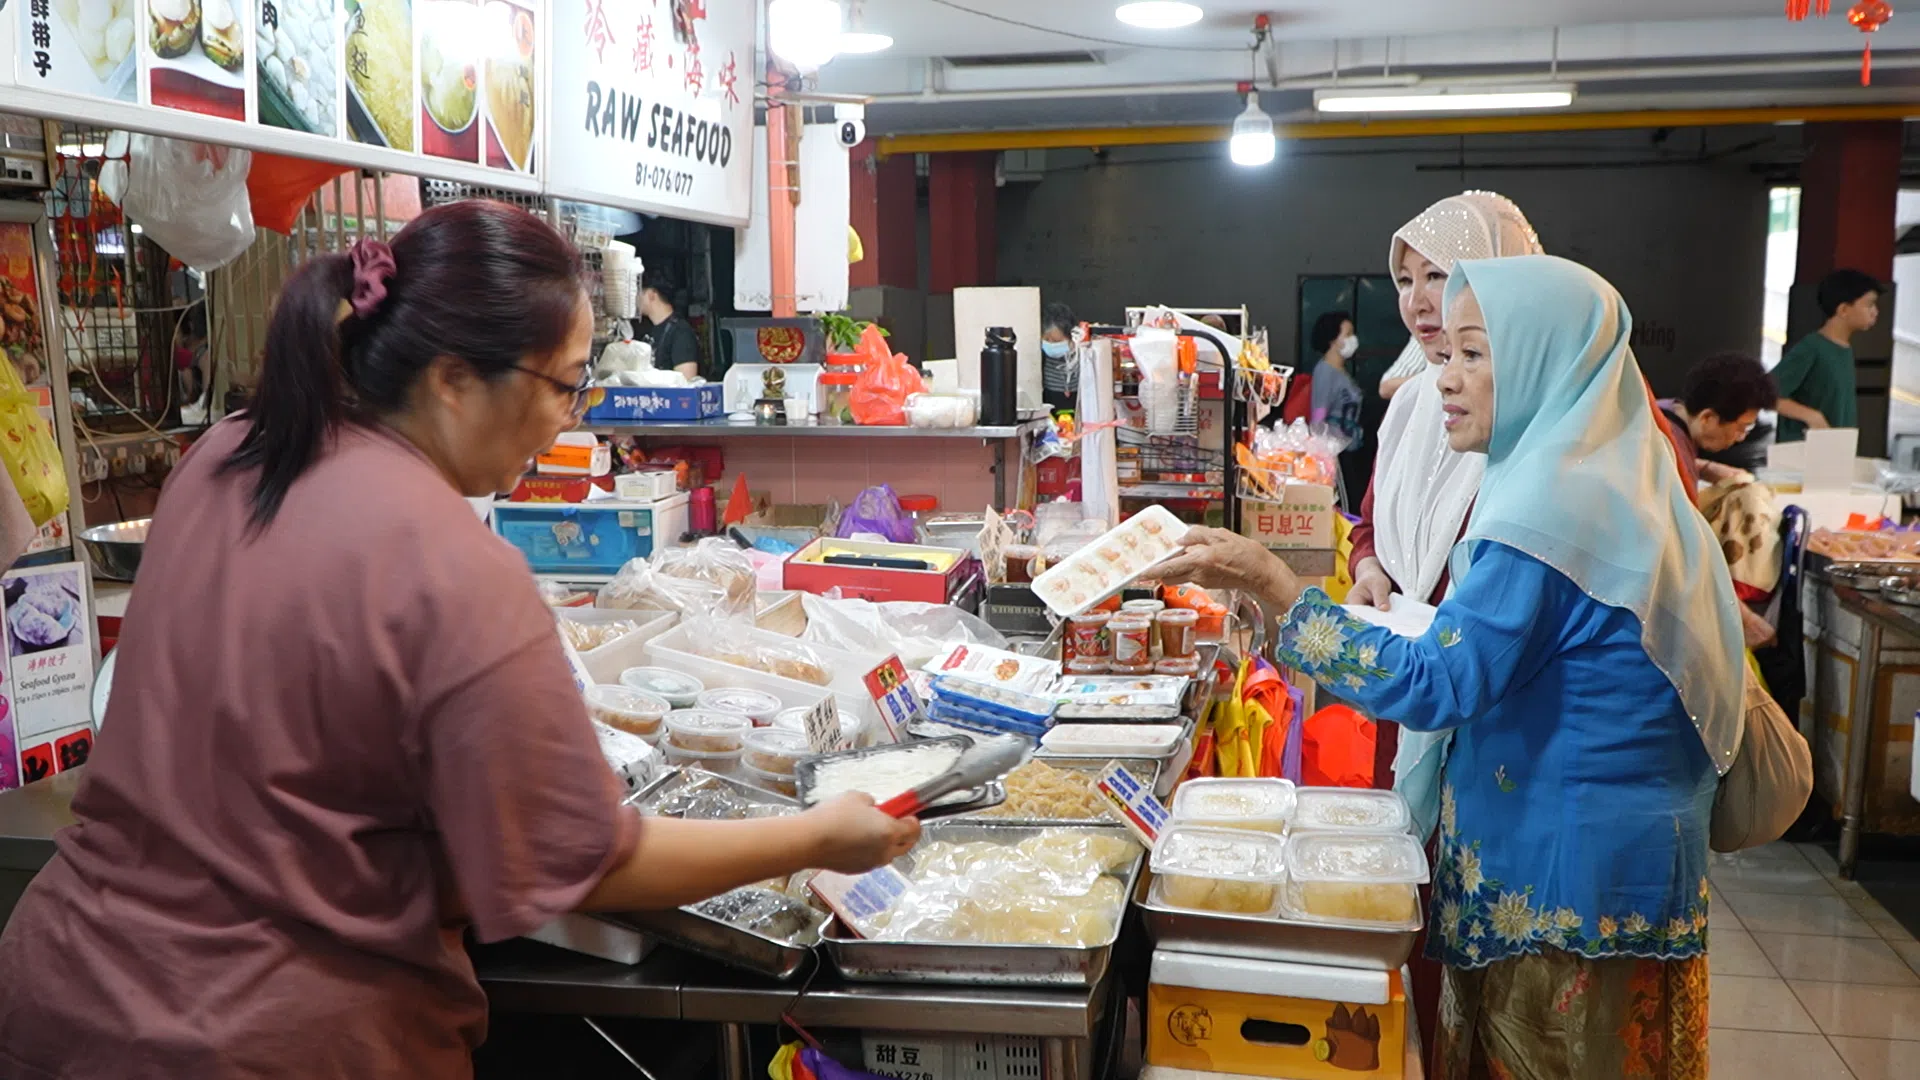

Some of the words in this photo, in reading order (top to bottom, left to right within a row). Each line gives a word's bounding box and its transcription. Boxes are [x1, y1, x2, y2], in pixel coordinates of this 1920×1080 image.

[585, 80, 642, 143] RAW
[647, 103, 731, 168] SEAFOOD
[1631, 320, 1676, 353] rking
[20, 675, 50, 690] Seafood
[52, 672, 76, 684] Gyoza
[876, 1044, 921, 1067] 甜豆
